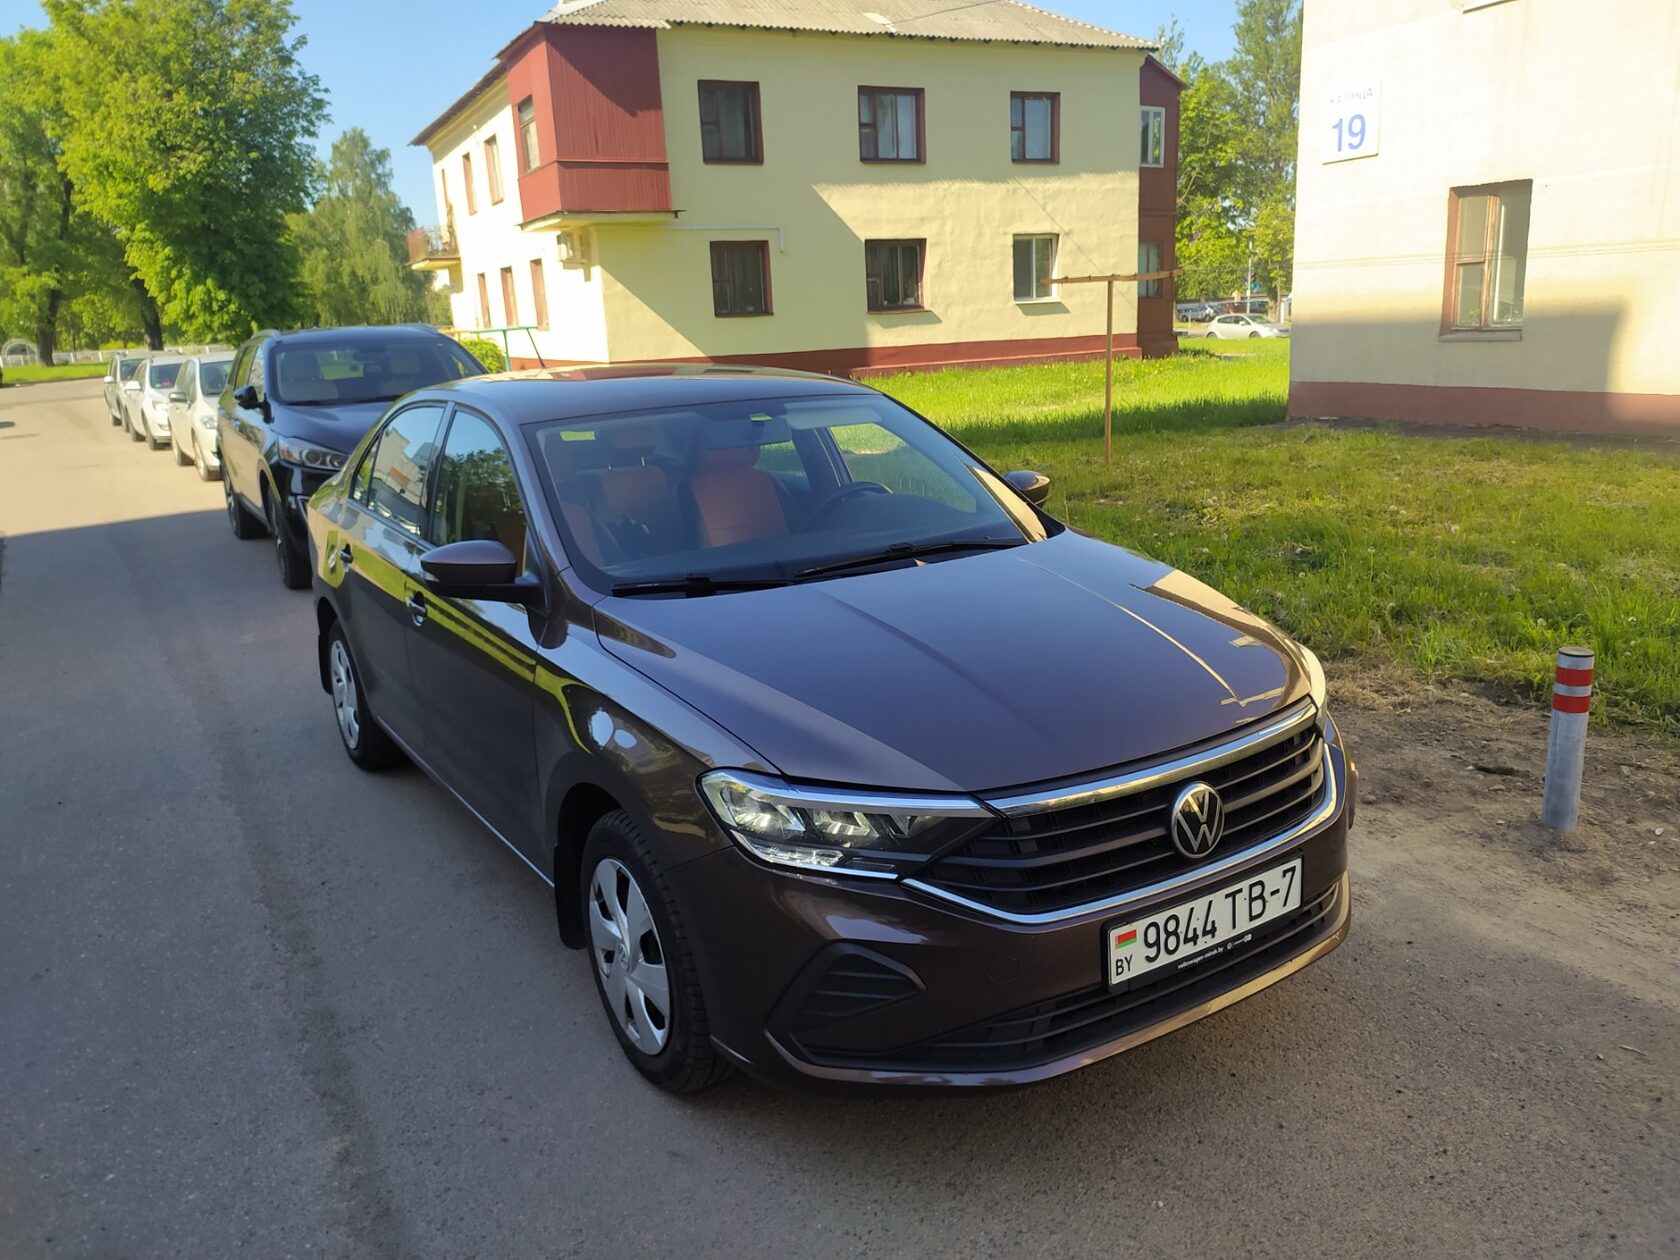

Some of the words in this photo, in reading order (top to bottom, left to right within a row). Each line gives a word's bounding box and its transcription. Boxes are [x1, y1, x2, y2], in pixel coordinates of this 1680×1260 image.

[1332, 114, 1366, 152] 19
[1143, 900, 1217, 963] 9844
[1225, 865, 1297, 930] TB-7
[1116, 954, 1133, 976] BY
